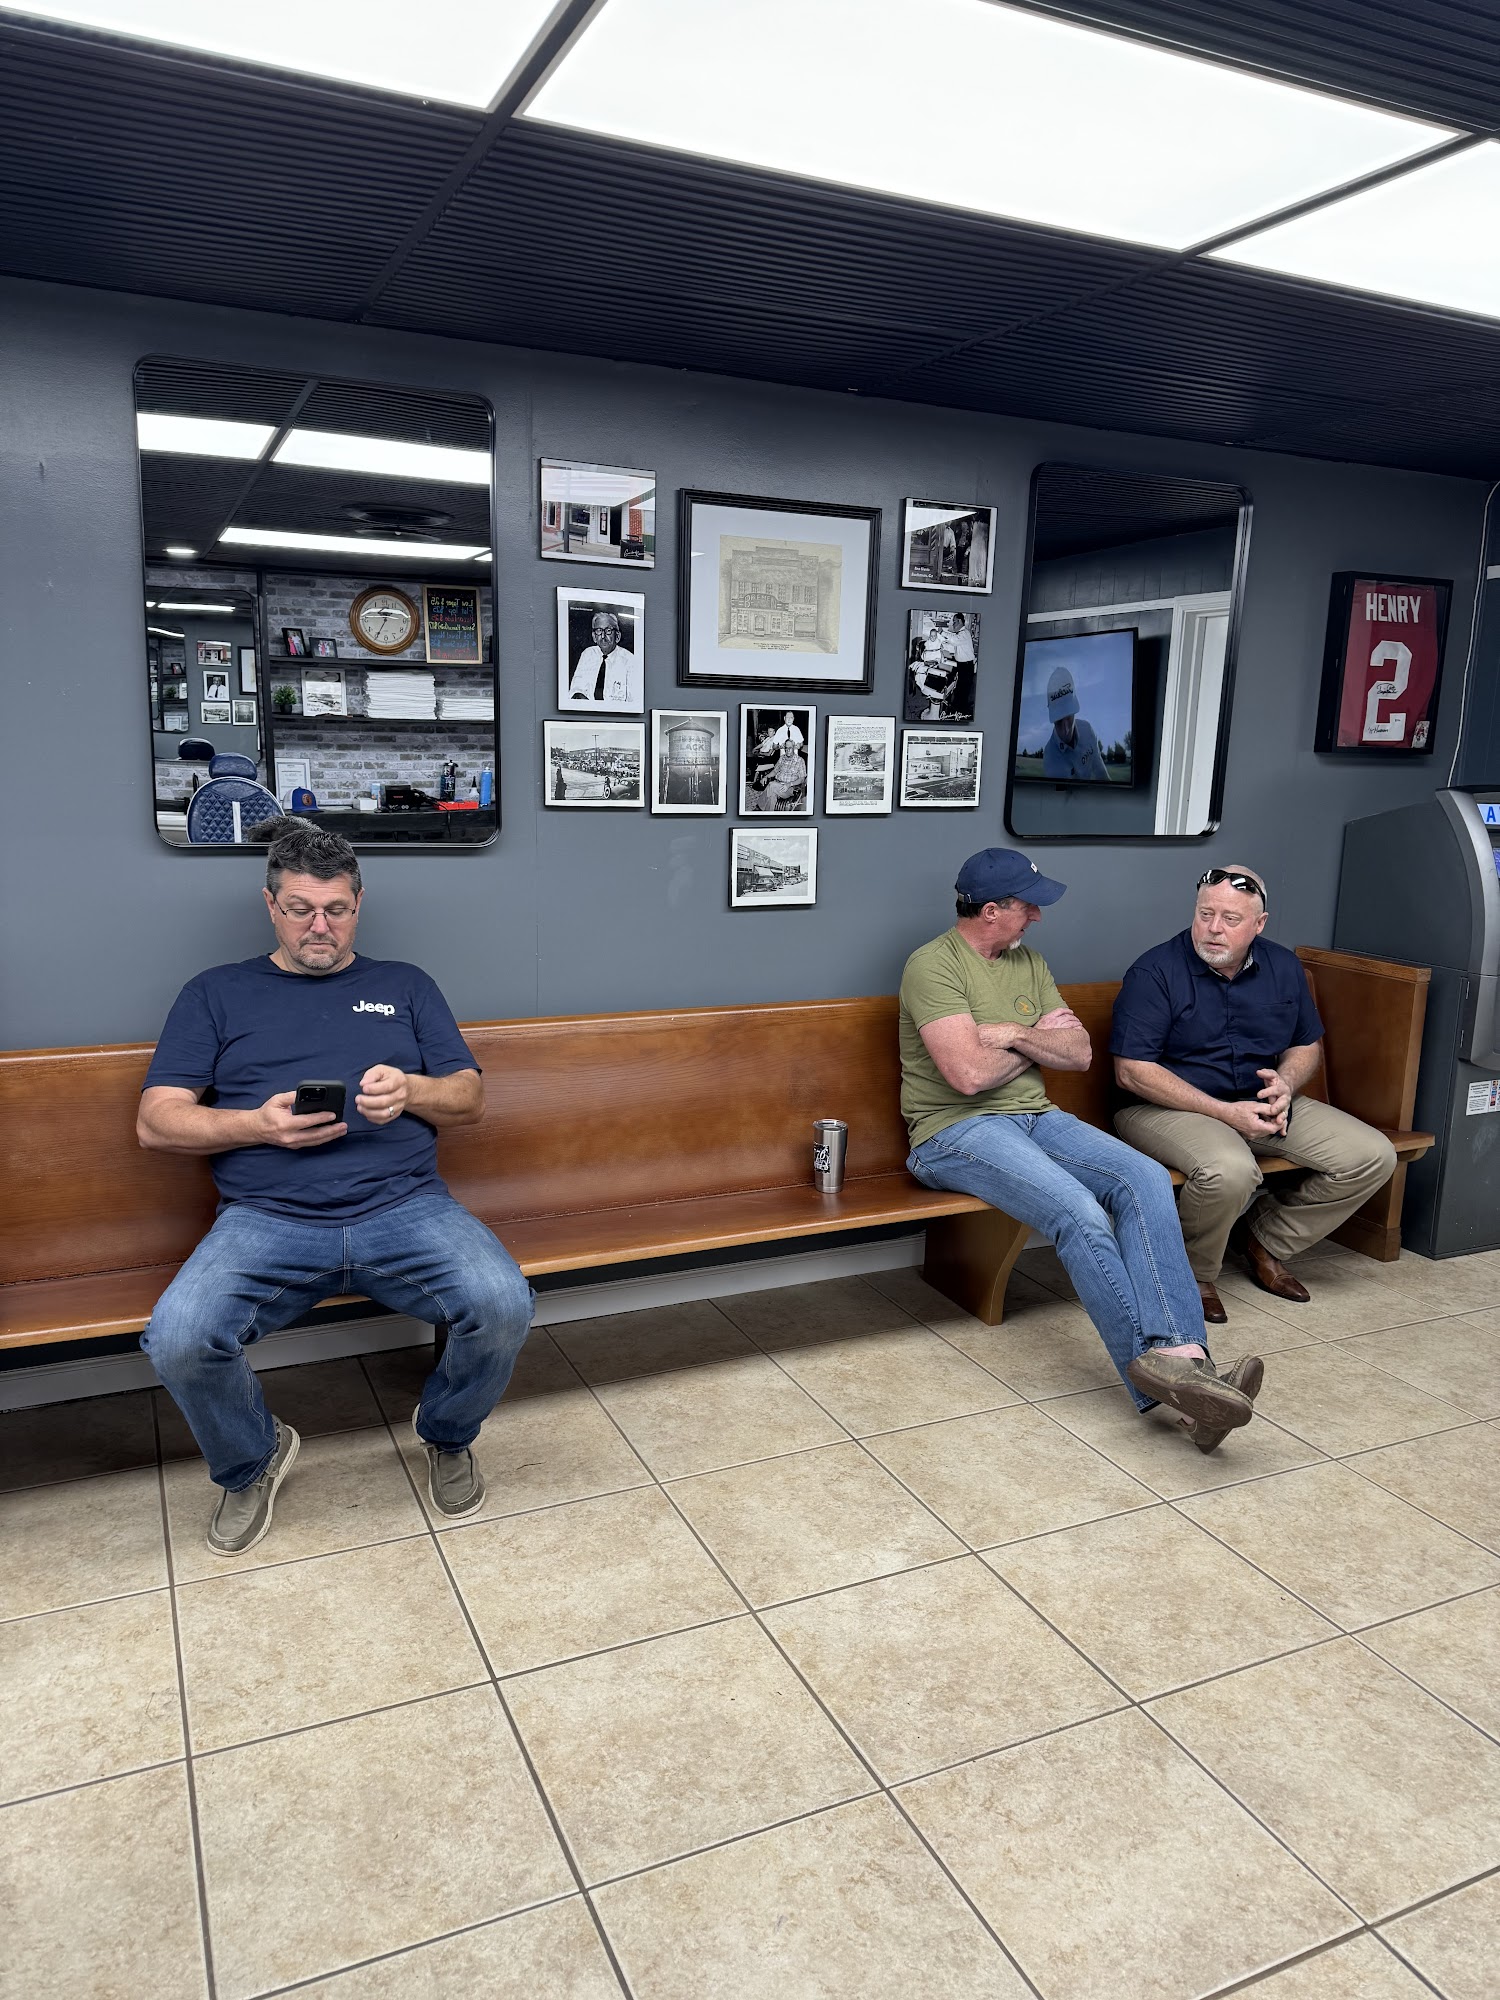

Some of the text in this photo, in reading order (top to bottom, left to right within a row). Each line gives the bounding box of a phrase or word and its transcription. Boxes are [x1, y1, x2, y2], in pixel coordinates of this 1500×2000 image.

[1366, 592, 1421, 623] HENRY
[1362, 640, 1413, 741] 2
[352, 1000, 395, 1016] Jeep
